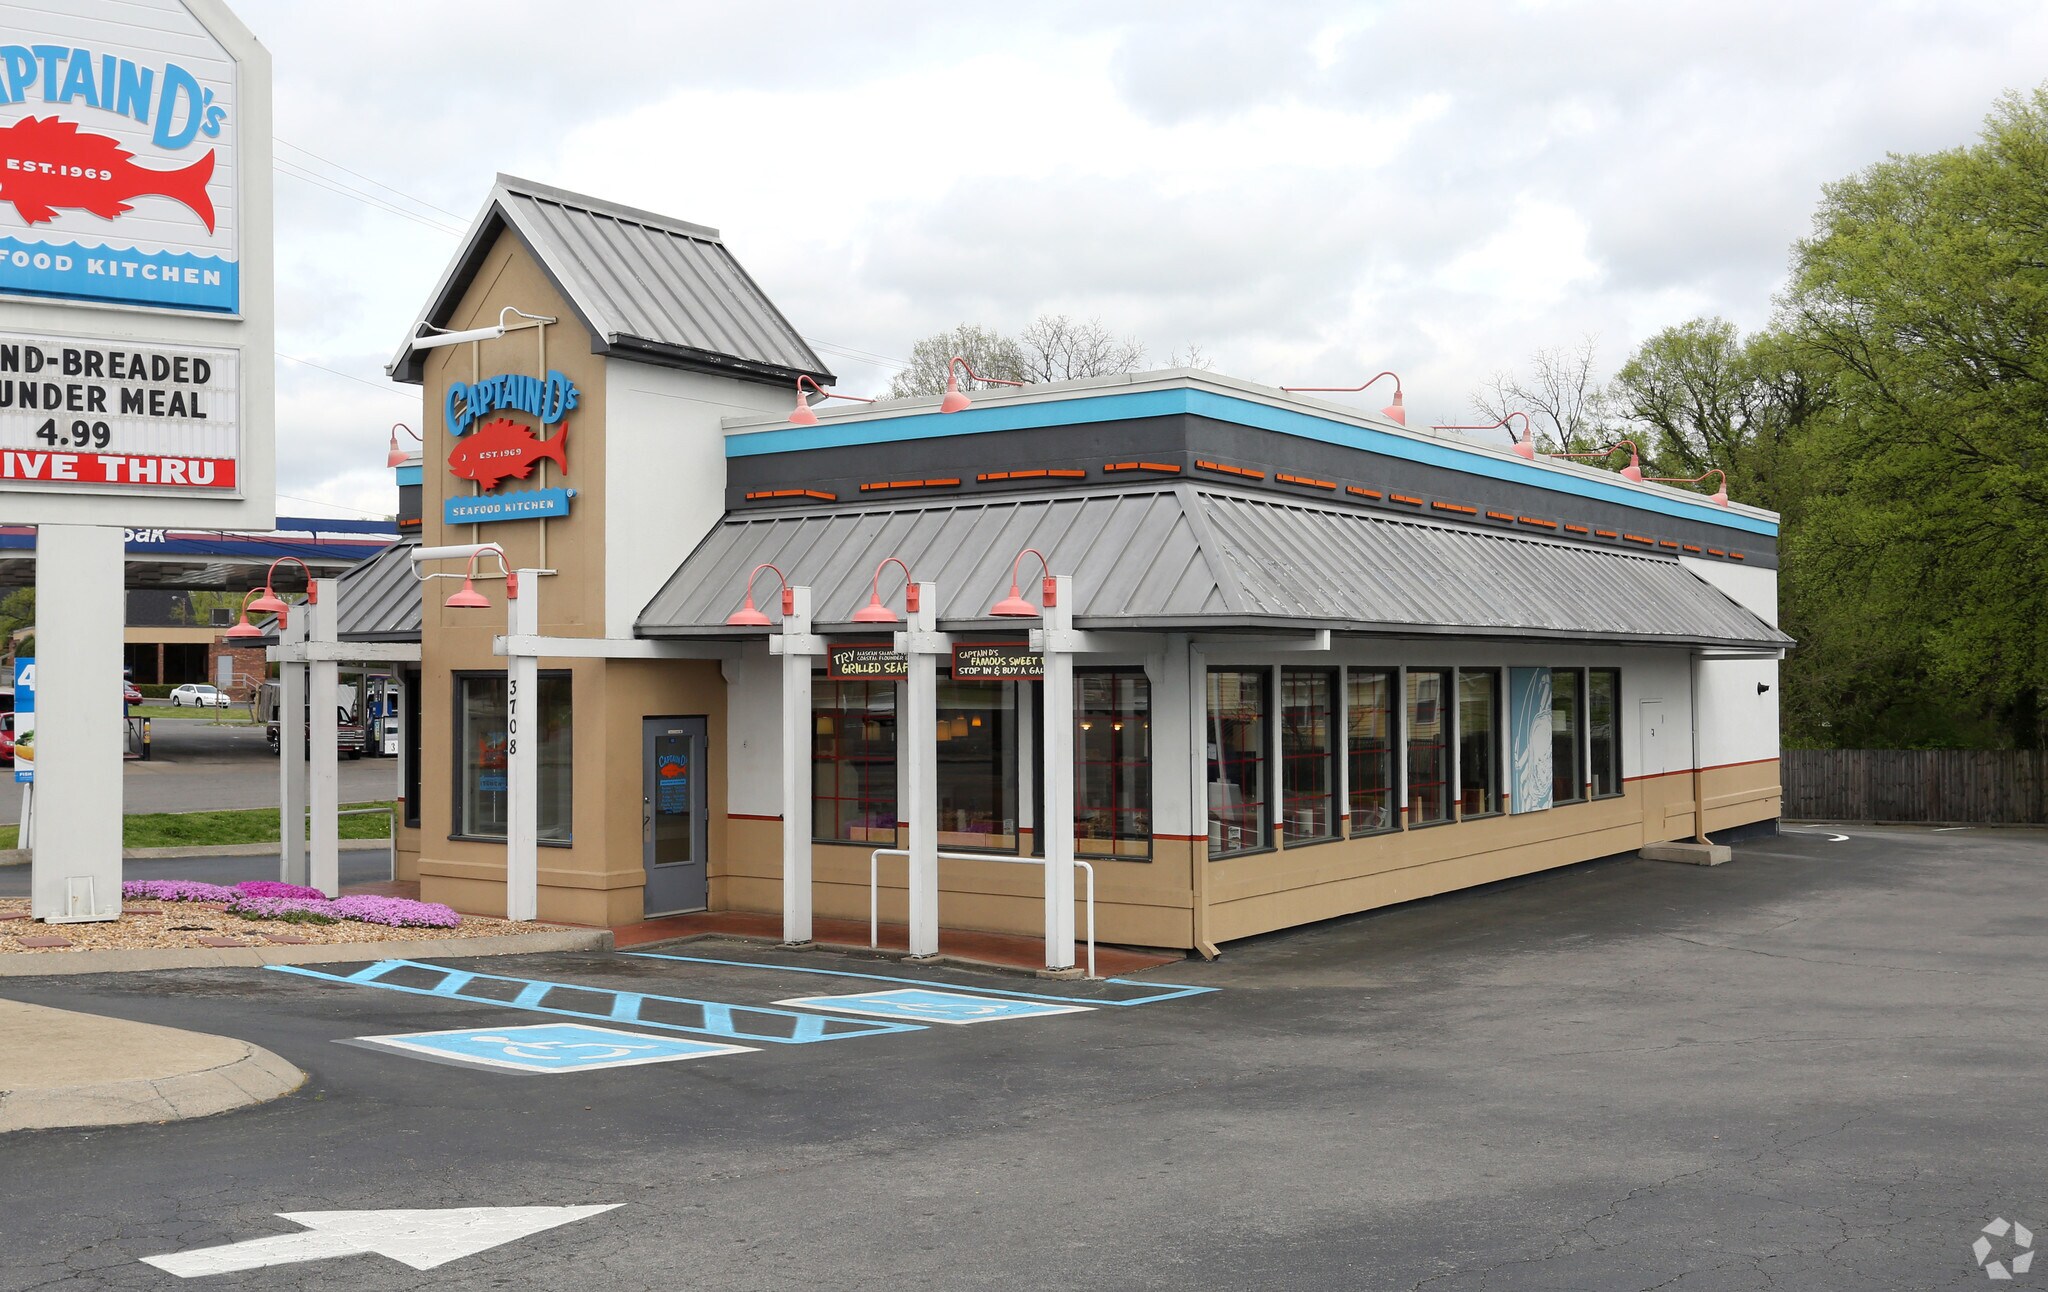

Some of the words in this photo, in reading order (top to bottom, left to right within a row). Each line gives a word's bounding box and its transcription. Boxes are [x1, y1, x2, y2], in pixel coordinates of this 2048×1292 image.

[0, 44, 154, 125] PTAIN
[87, 259, 221, 286] KITCHEN
[120, 387, 207, 419] MEAL
[445, 374, 544, 437] CAPTAIN
[36, 418, 111, 449] 4.99
[97, 456, 215, 485] THRU
[452, 504, 501, 516] SEAFOOD
[504, 500, 555, 512] KITCHEN
[833, 650, 855, 665] TRY
[959, 649, 988, 659] CAPTAIN
[971, 657, 1007, 667] FAMOUS
[1008, 656, 1038, 667] SWEET
[841, 662, 881, 674] GRILLED
[884, 662, 908, 674] SEAF
[958, 666, 981, 675] STOP
[983, 666, 992, 675] IN
[993, 665, 1001, 677] &
[1002, 666, 1019, 675] BUY
[1020, 666, 1027, 675] A
